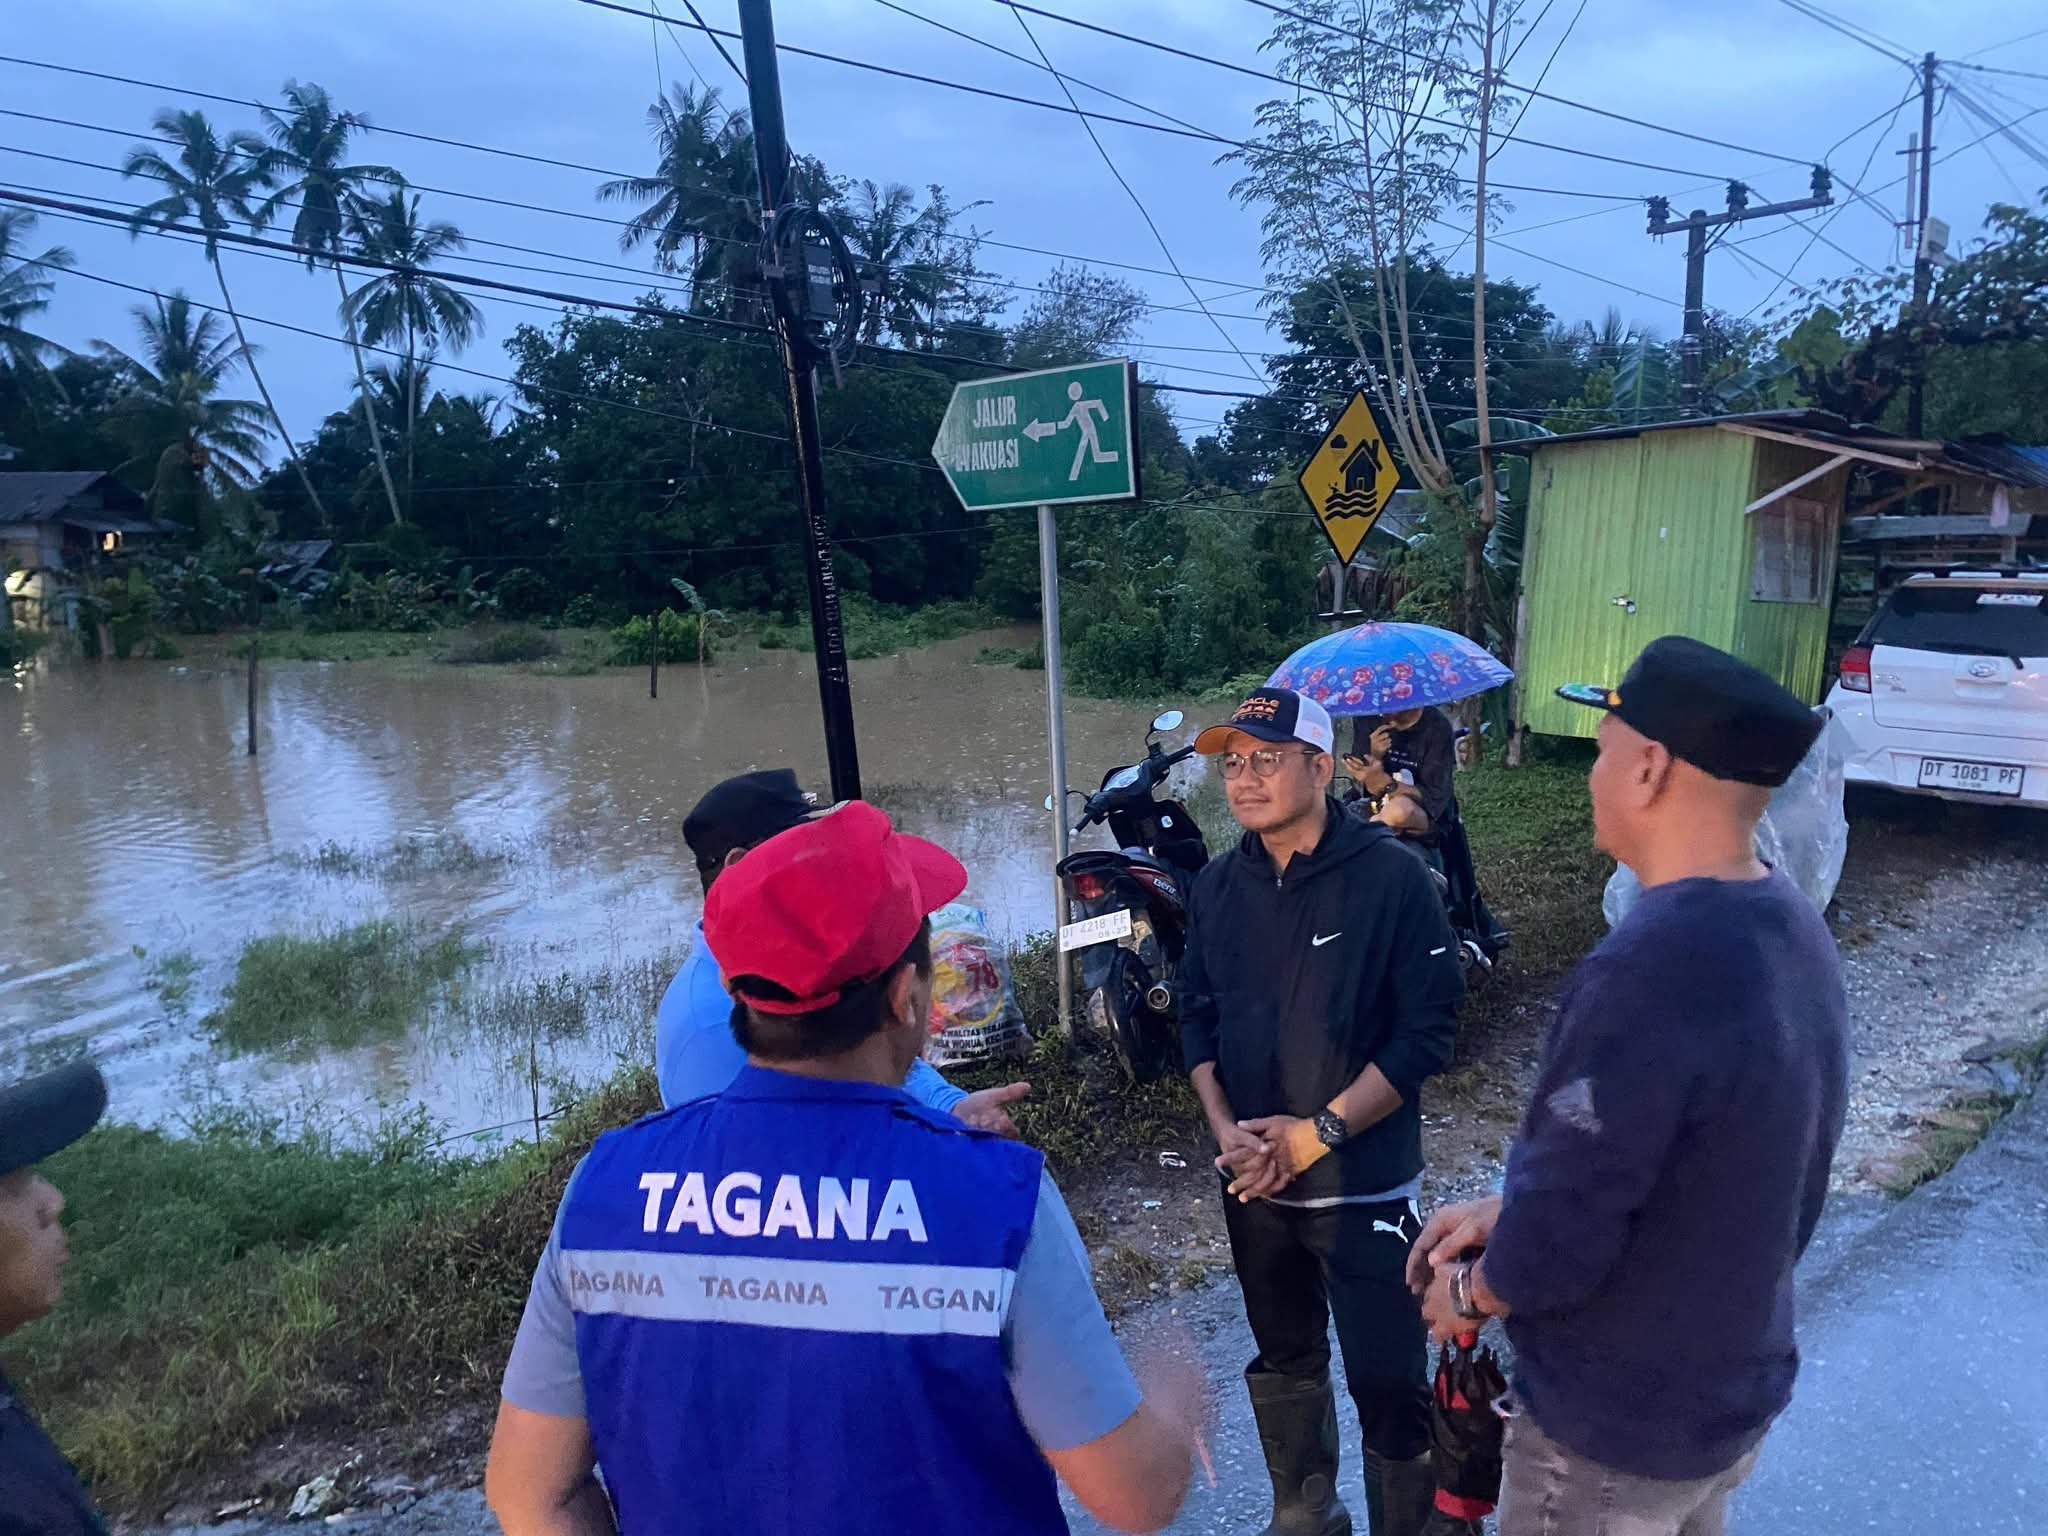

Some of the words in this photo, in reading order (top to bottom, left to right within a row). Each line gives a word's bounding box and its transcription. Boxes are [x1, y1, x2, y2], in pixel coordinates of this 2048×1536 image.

[973, 396, 1017, 428] JALUR
[1924, 761, 1945, 776] DT
[1951, 764, 1990, 781] 1081
[1998, 768, 2018, 784] PF
[965, 960, 999, 992] 78
[639, 1171, 929, 1242] TAGANA
[699, 1275, 828, 1306] TAGANA
[878, 1286, 1001, 1312] TAGAN
